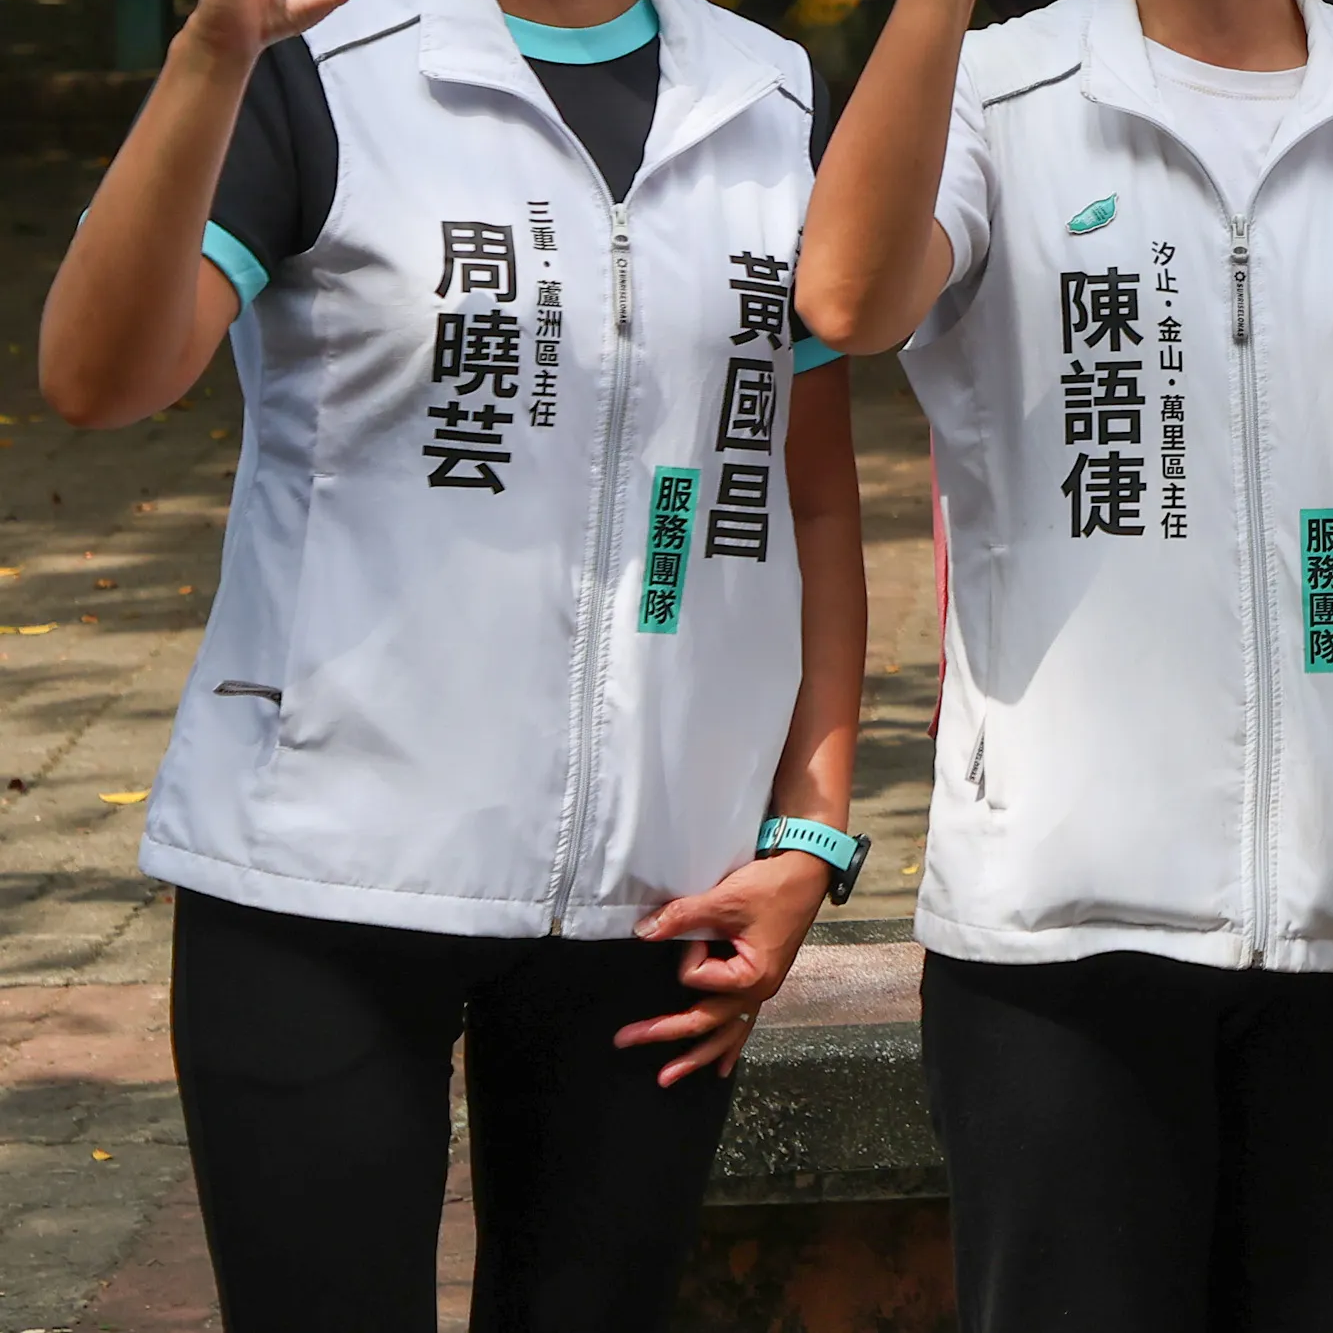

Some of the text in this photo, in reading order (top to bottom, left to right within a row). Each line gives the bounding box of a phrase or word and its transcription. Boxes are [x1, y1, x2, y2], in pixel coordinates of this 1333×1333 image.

[422, 220, 521, 496] 周曉芸
[704, 250, 790, 563] 黃國昌
[1060, 267, 1147, 539] 陳語倢
[643, 477, 693, 625] 服務團隊
